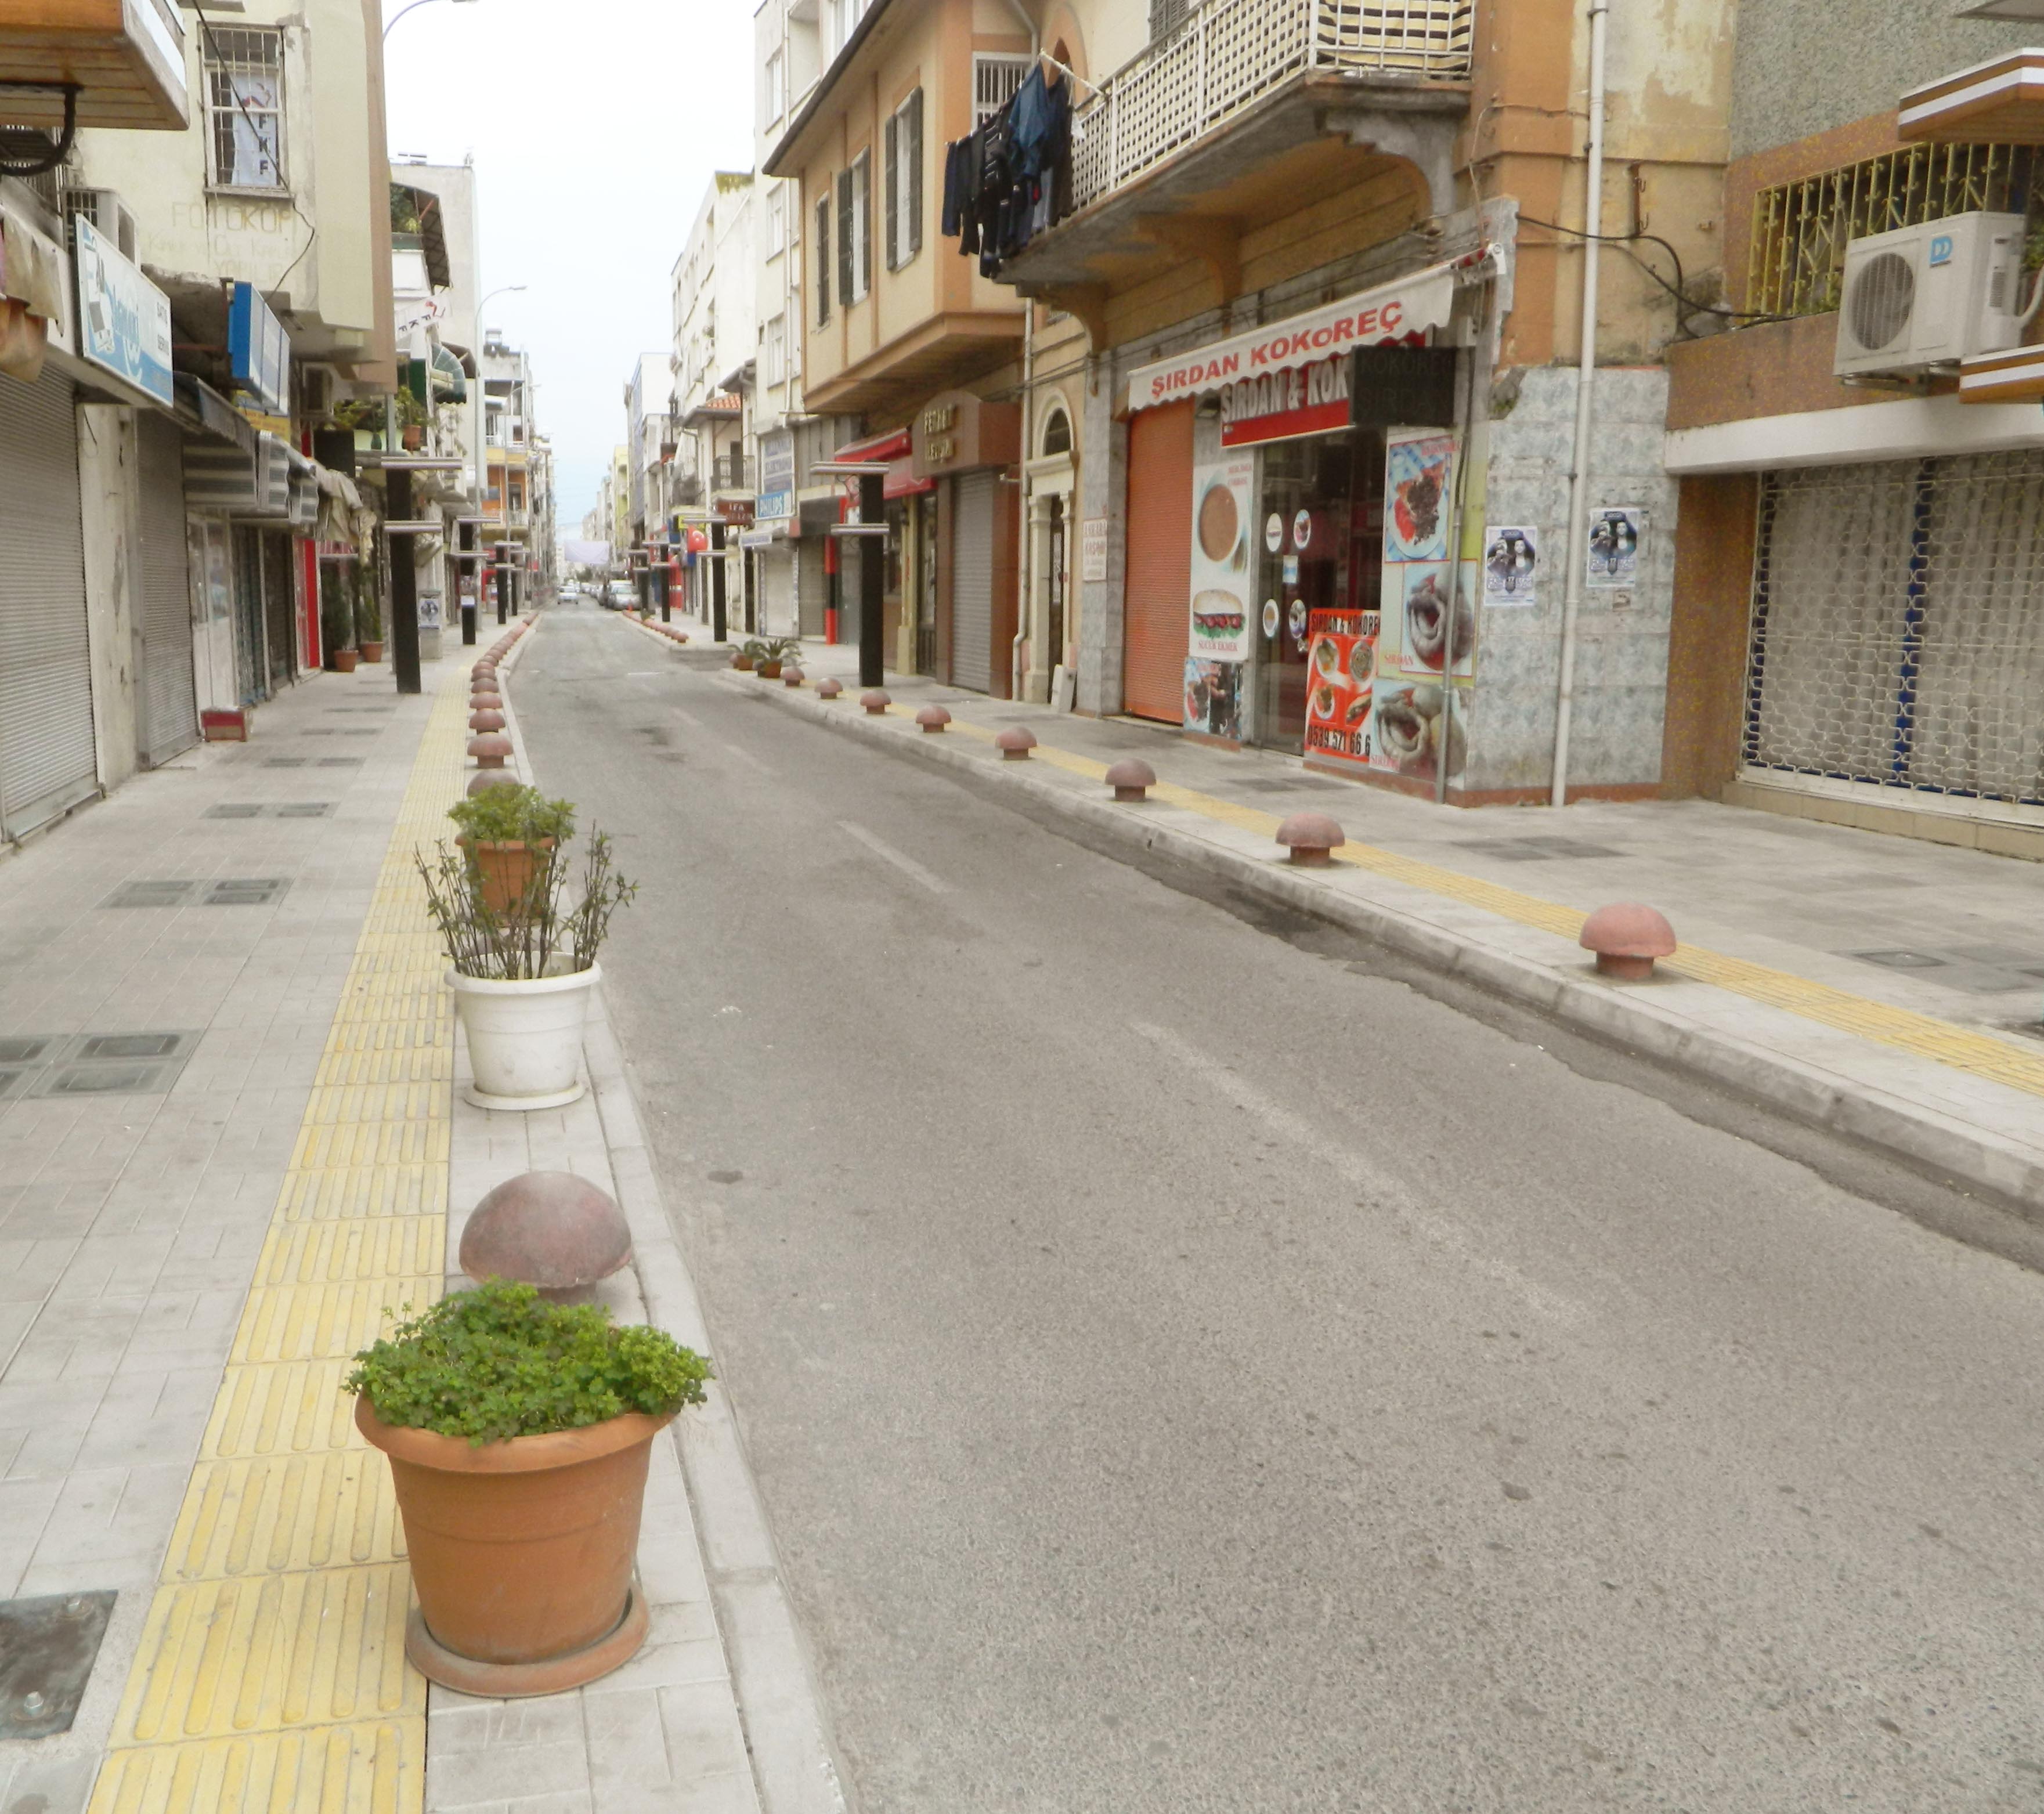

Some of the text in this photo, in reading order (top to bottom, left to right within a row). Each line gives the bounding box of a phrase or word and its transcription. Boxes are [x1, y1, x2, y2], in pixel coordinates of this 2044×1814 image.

[1250, 301, 1403, 368] KOKOREÇ
[1287, 370, 1301, 411] &
[759, 495, 782, 517] PHILIPS
[1307, 725, 1329, 748] 0539
[1332, 729, 1346, 751] 571
[1350, 732, 1362, 754] 66
